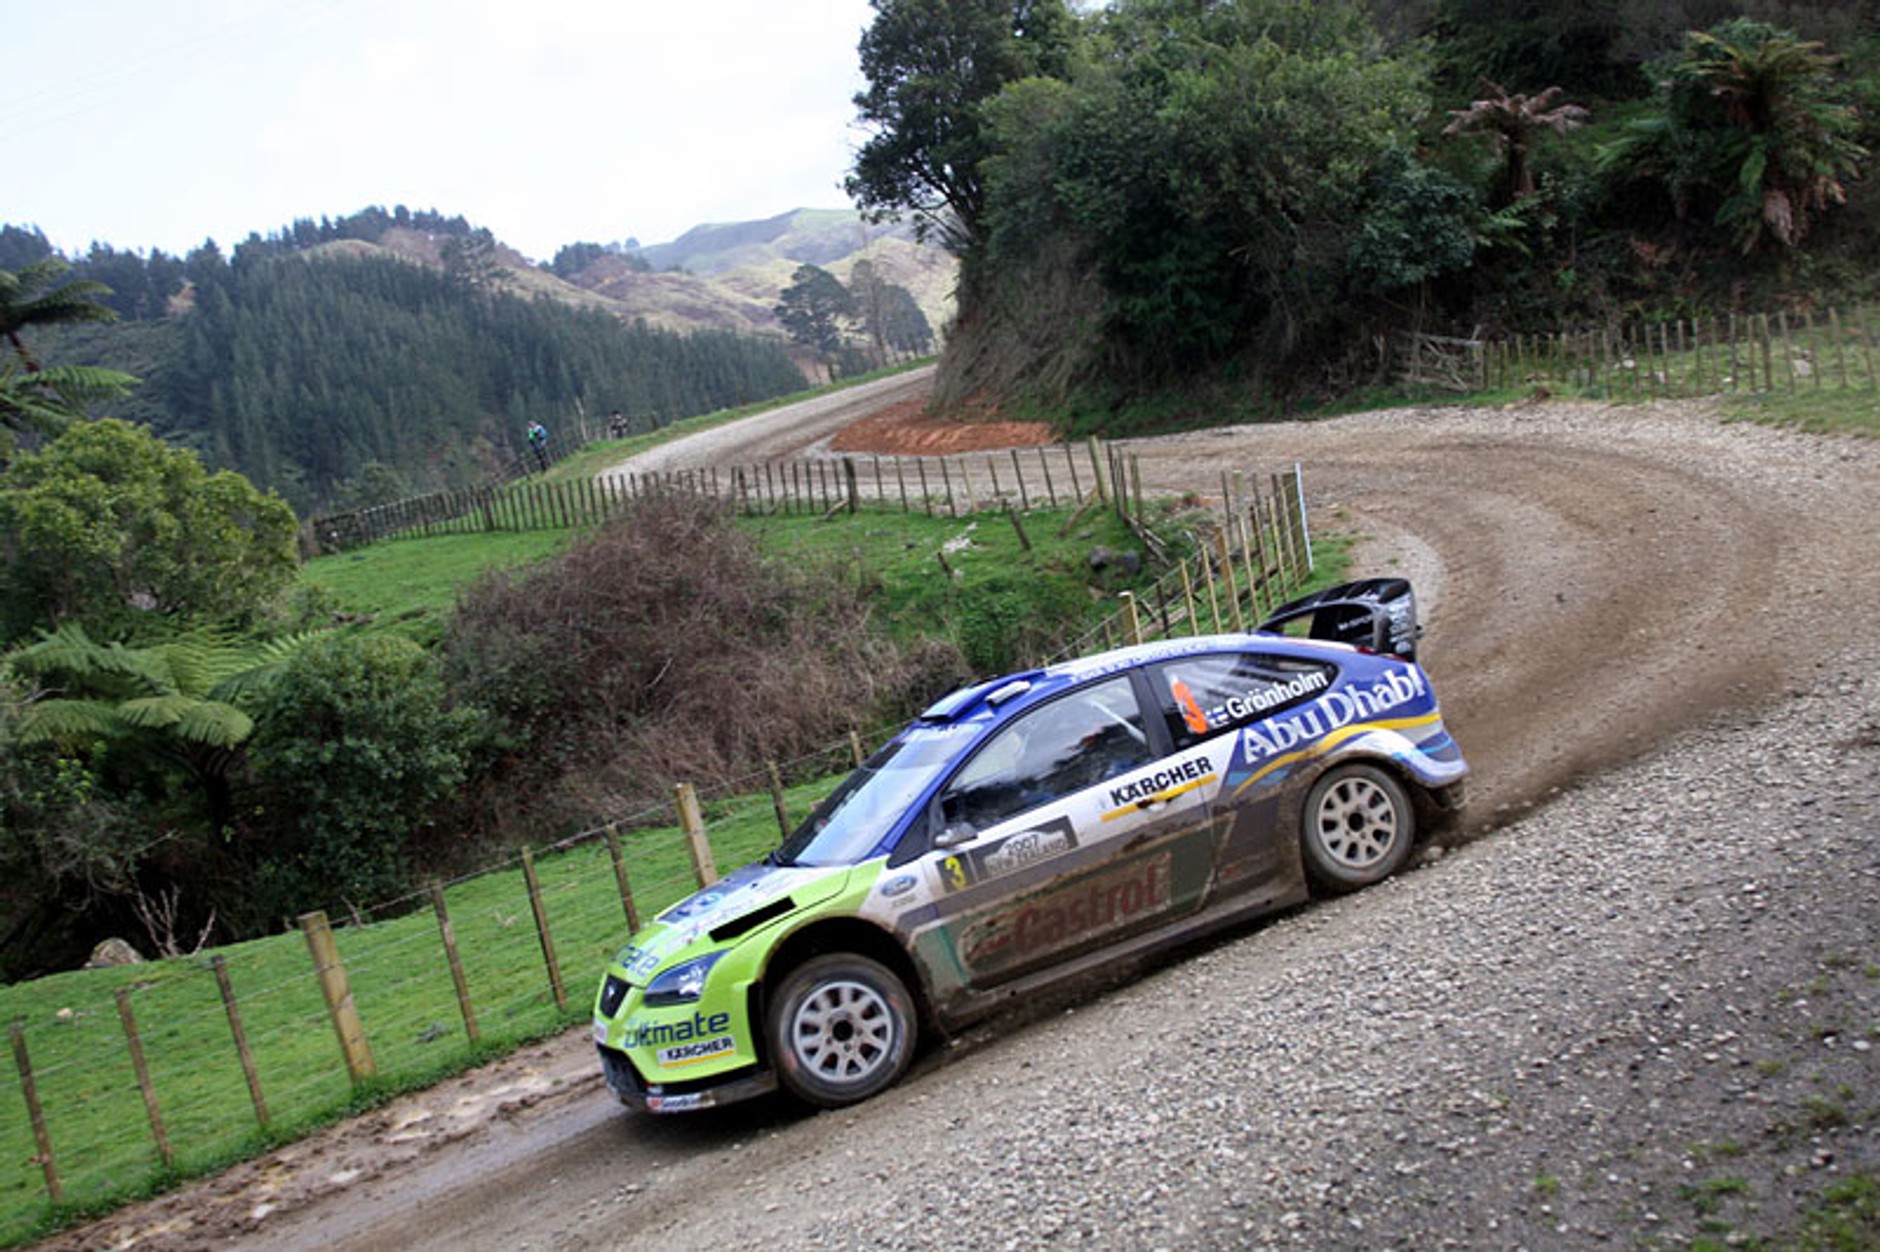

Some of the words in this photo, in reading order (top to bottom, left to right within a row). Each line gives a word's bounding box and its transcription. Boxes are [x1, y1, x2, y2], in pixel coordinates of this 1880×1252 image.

[1227, 671, 1329, 718] Grönholm
[1243, 710, 1326, 764] Abu
[1005, 834, 1039, 856] 2007
[944, 855, 967, 890] 3
[1015, 863, 1160, 950] Castrol
